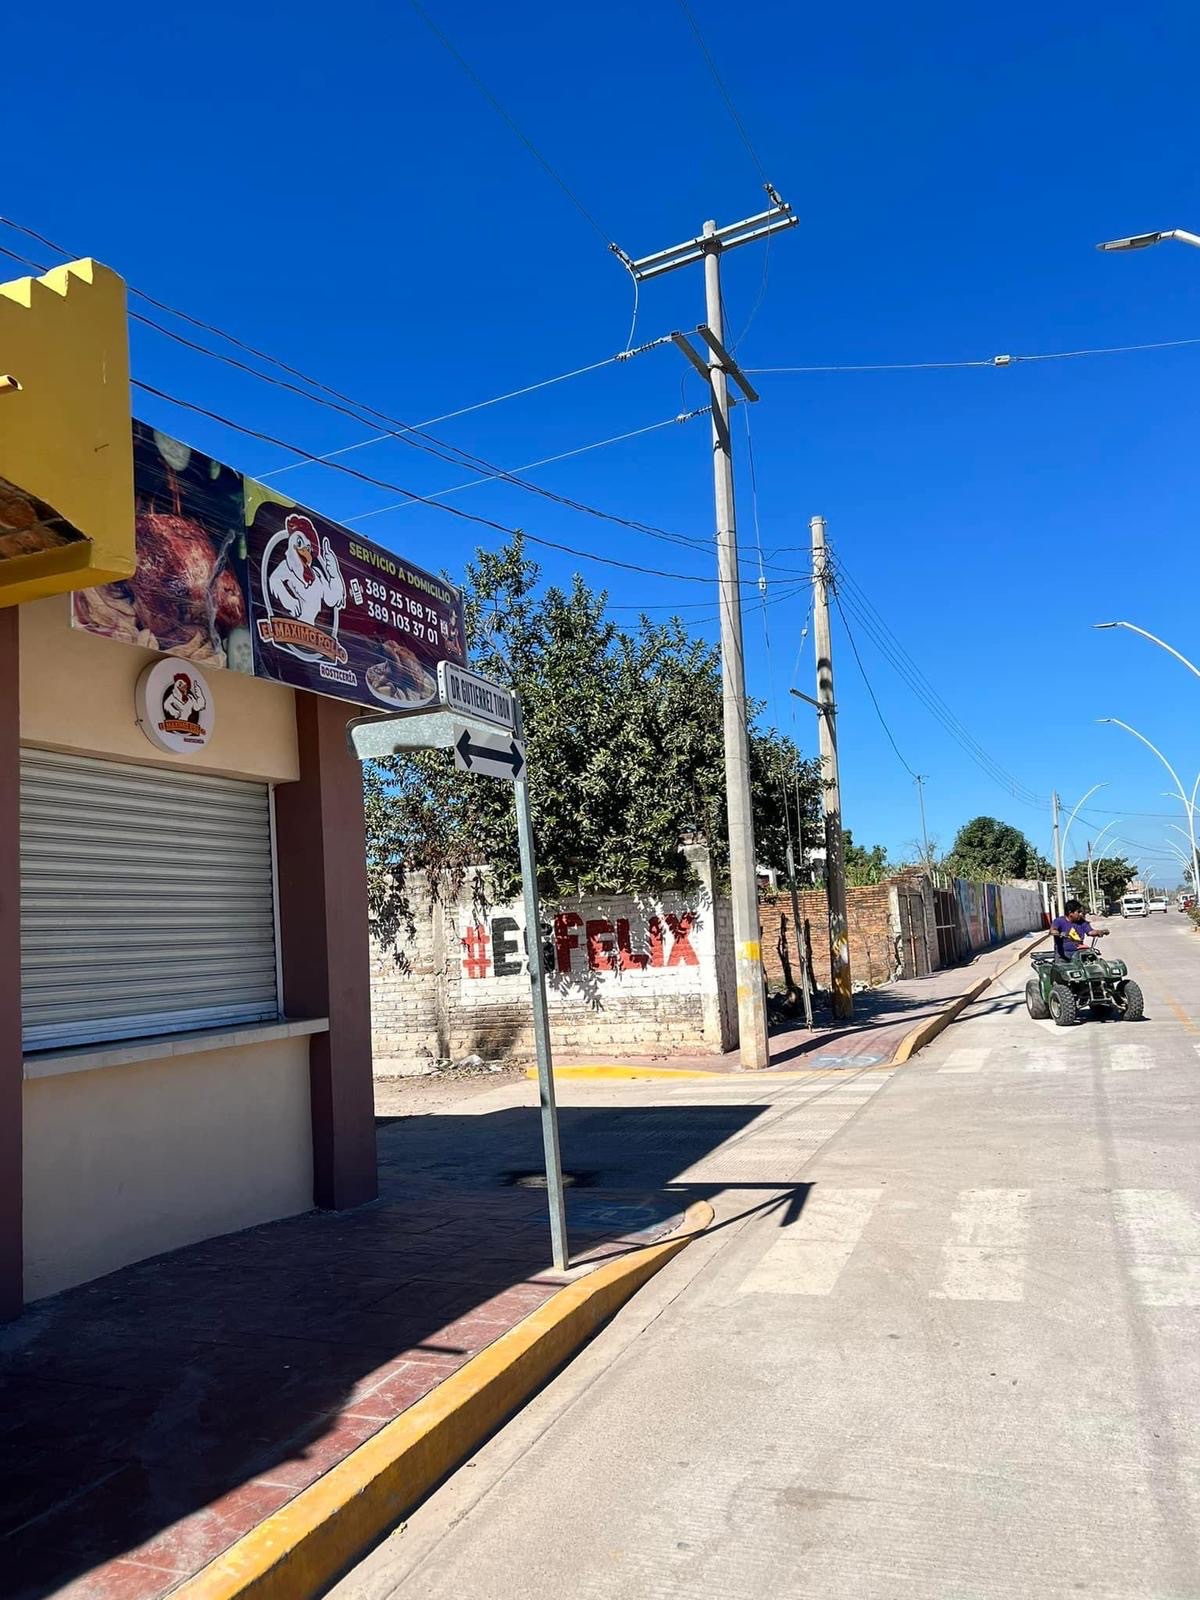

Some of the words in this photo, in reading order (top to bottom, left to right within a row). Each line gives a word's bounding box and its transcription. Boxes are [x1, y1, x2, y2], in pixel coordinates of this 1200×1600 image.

[349, 542, 396, 575] SERVICIO
[398, 567, 406, 581] A
[407, 571, 451, 604] DOMICILIO
[365, 578, 387, 601] 389
[389, 591, 403, 609] 25
[405, 598, 423, 619] 168
[425, 607, 438, 626] 75
[367, 601, 389, 623] 389
[391, 611, 410, 633] 103
[412, 621, 424, 639] 37
[427, 630, 439, 646] 01
[273, 623, 317, 643] MAXIMO
[450, 674, 461, 701] DR
[461, 679, 494, 713] GUTIERREZ
